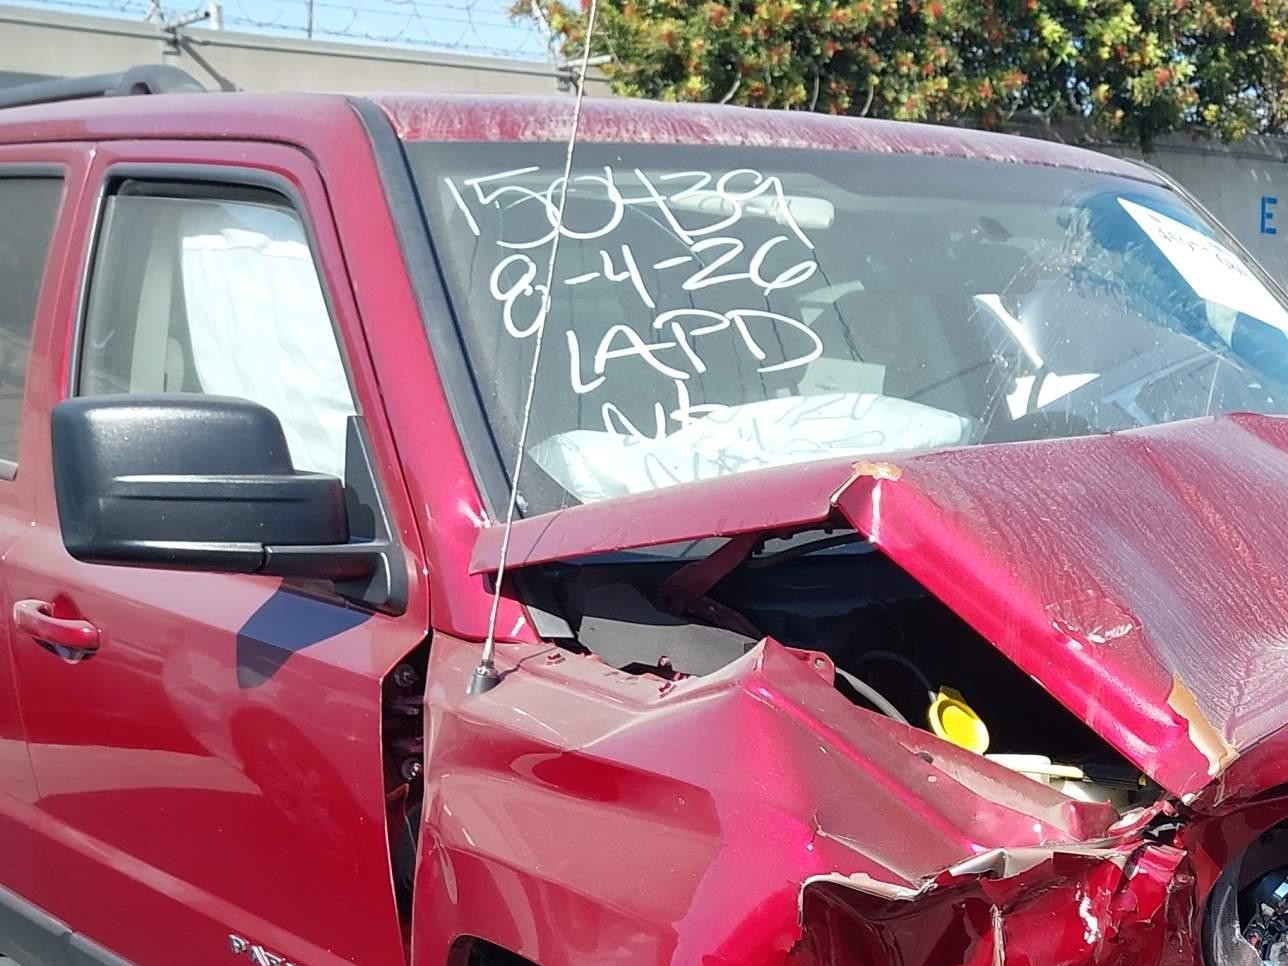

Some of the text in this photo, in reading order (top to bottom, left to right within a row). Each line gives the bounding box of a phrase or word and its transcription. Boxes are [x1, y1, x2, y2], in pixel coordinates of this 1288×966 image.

[1260, 195, 1279, 236] E
[490, 235, 818, 339] 8-4-26
[566, 308, 824, 393] LAPD
